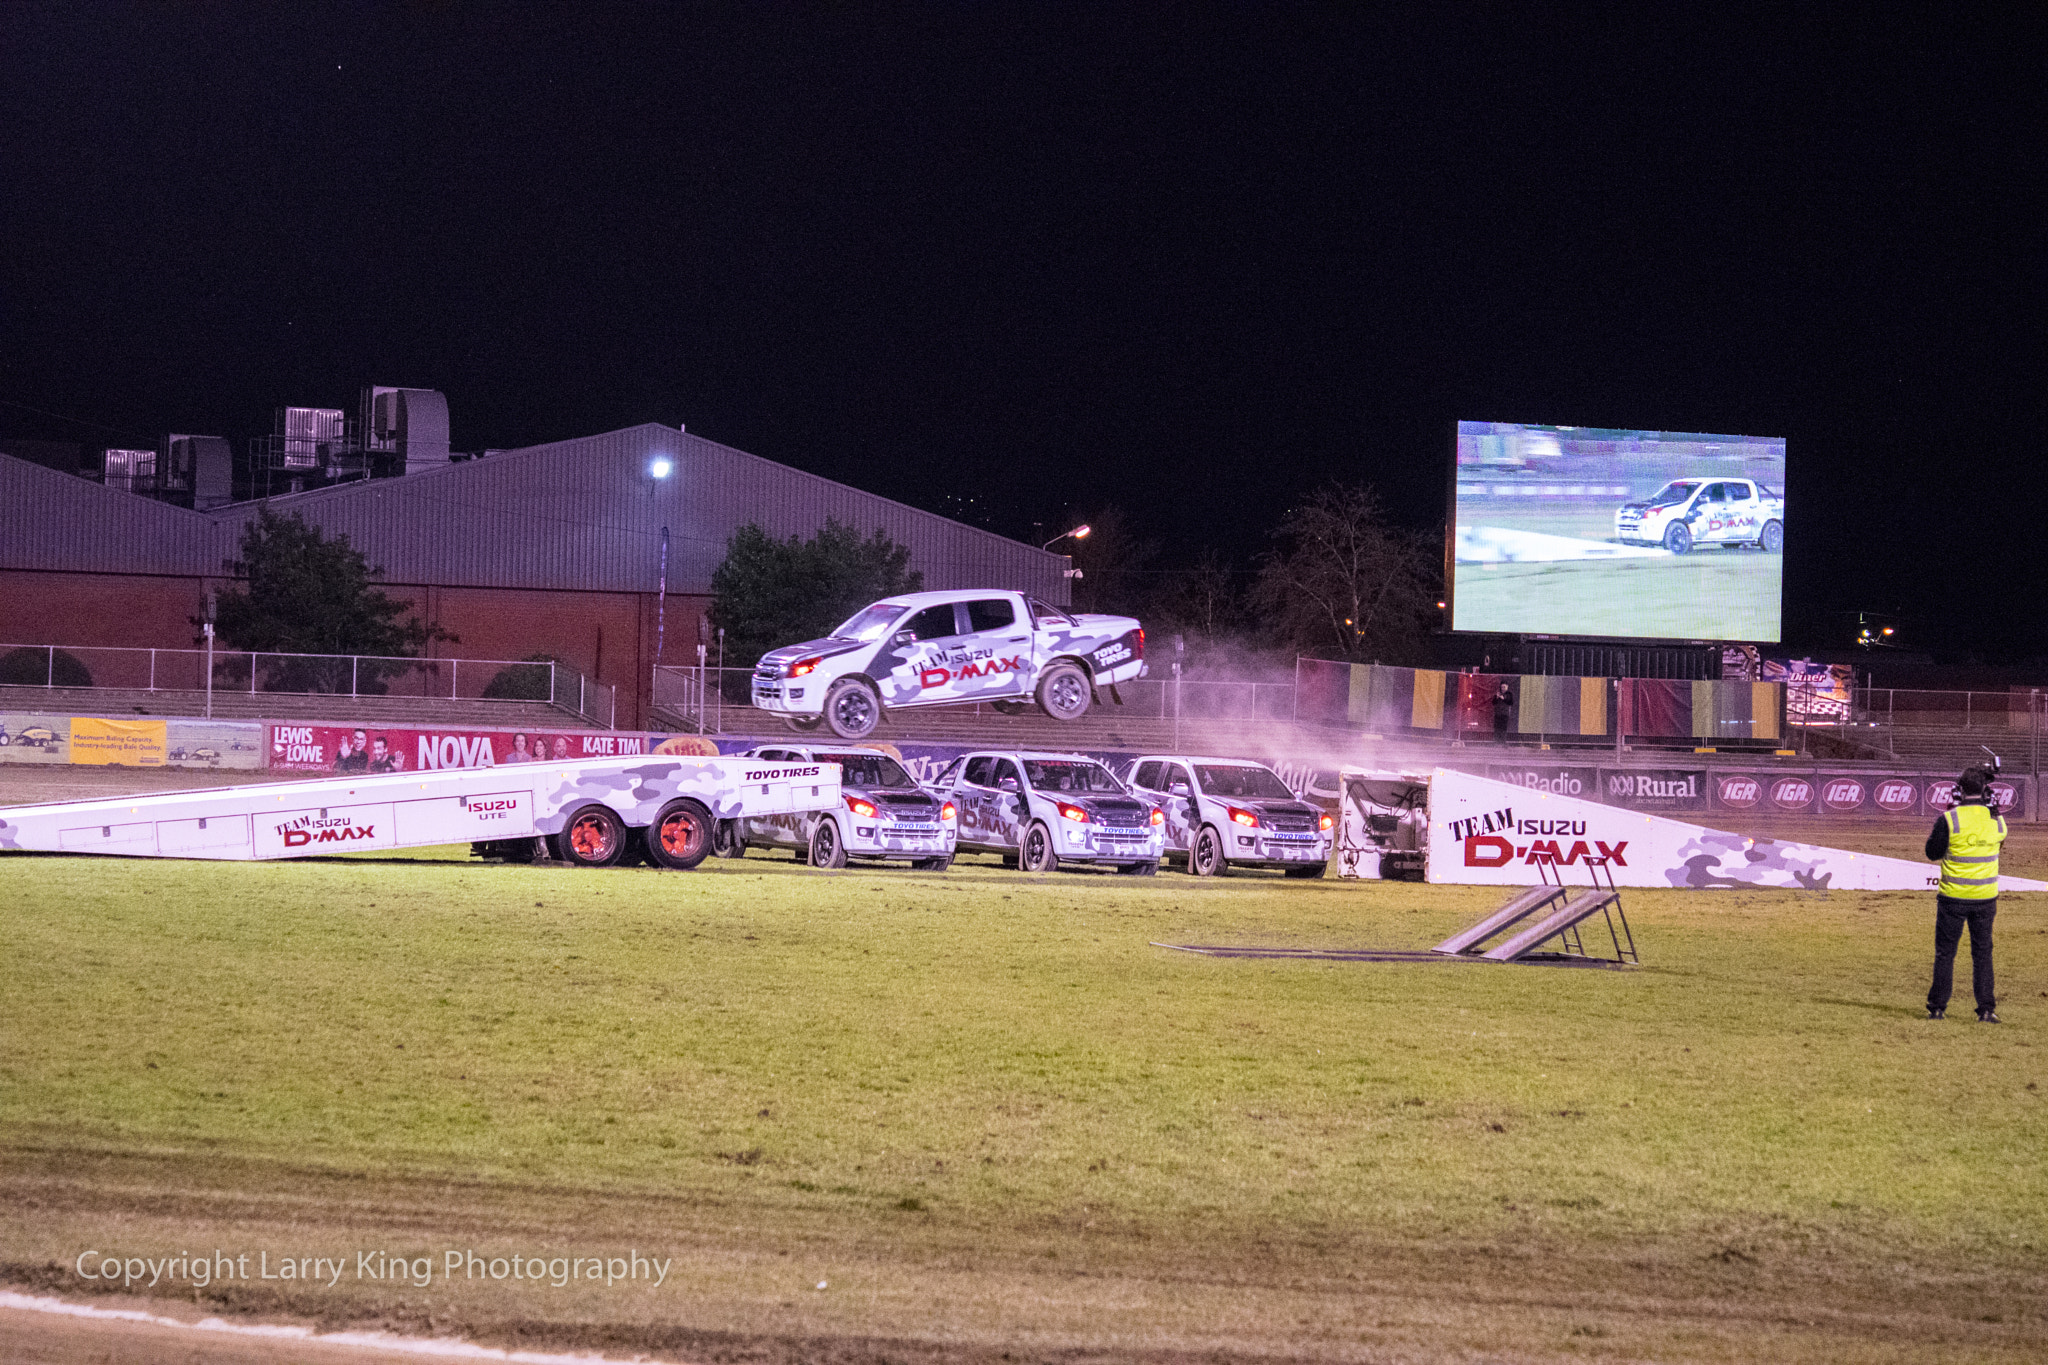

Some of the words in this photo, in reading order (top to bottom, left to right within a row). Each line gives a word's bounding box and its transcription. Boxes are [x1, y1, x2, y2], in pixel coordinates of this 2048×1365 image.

[1093, 642, 1123, 660] TOYO
[1100, 648, 1132, 667] TIRES
[909, 651, 948, 676] TEAM
[950, 648, 993, 664] ISUZU
[1791, 671, 1826, 683] Diner
[106, 735, 125, 743] Baling
[274, 727, 313, 745] LEWIS
[286, 744, 324, 763] LOWE
[417, 735, 495, 770] NOVA
[582, 736, 614, 754] KATE
[617, 738, 640, 755] TIM
[745, 770, 781, 780] TOYO
[782, 766, 820, 777] TIRES
[1524, 772, 1582, 795] Radio
[1636, 775, 1697, 798] Rural
[1723, 782, 1757, 799] IGA
[1775, 783, 1809, 801] IGA
[1827, 784, 1860, 802] IGA
[1879, 785, 1912, 803] IGA
[468, 800, 517, 812] ISUZU
[479, 812, 507, 820] UTE
[1449, 808, 1514, 842] TEAM
[1517, 819, 1586, 835] ISUZU
[274, 816, 311, 836] TEAM
[312, 817, 351, 828] ISUZU
[284, 825, 375, 847] D-MAX
[1926, 877, 1940, 886] TO
